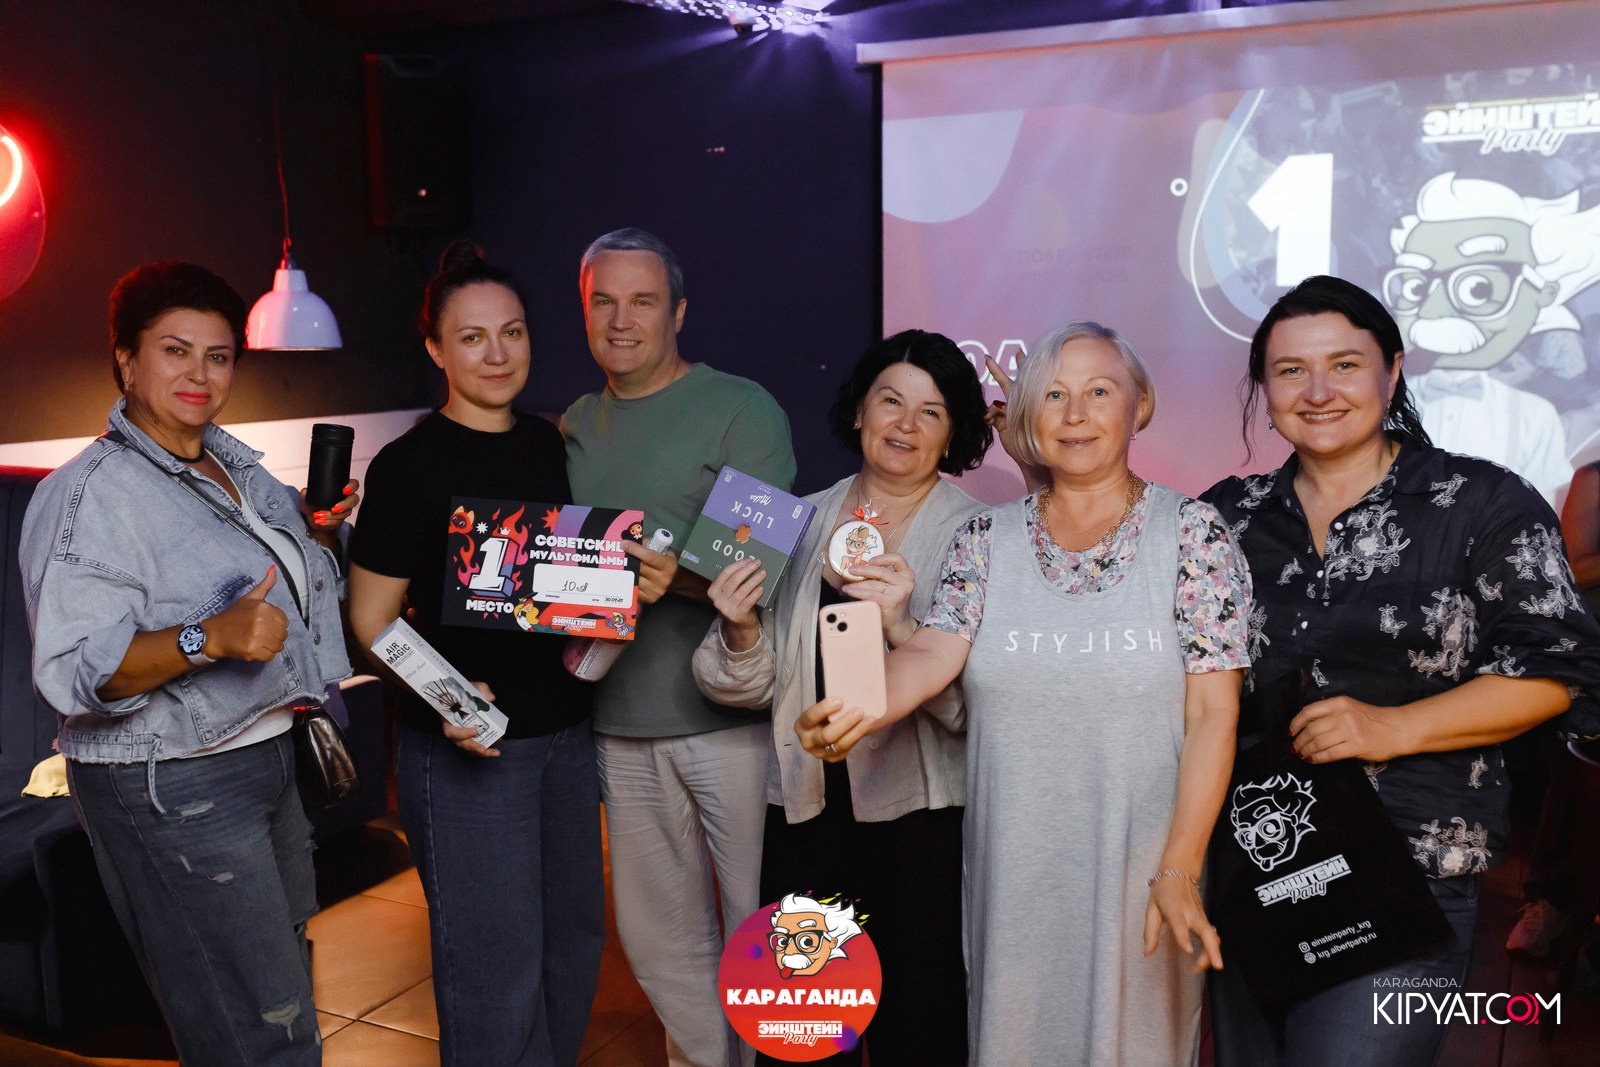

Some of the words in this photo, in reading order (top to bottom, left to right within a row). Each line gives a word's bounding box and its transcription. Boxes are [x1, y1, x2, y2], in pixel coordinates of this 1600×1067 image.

[1480, 127, 1567, 157] Party
[1246, 153, 1334, 287] 1
[730, 500, 775, 529] LUCK
[529, 549, 628, 567] МУЛЬТФИЛЬМЫ
[712, 539, 757, 562] OOD
[468, 536, 510, 592] 1
[465, 599, 515, 614] МЕСТО
[385, 642, 400, 655] AIR
[386, 643, 411, 665] MAGIC
[1289, 881, 1327, 904] Party
[1311, 920, 1372, 948] einsteinparty_krg
[1317, 932, 1377, 959] krg.albertparty.ru
